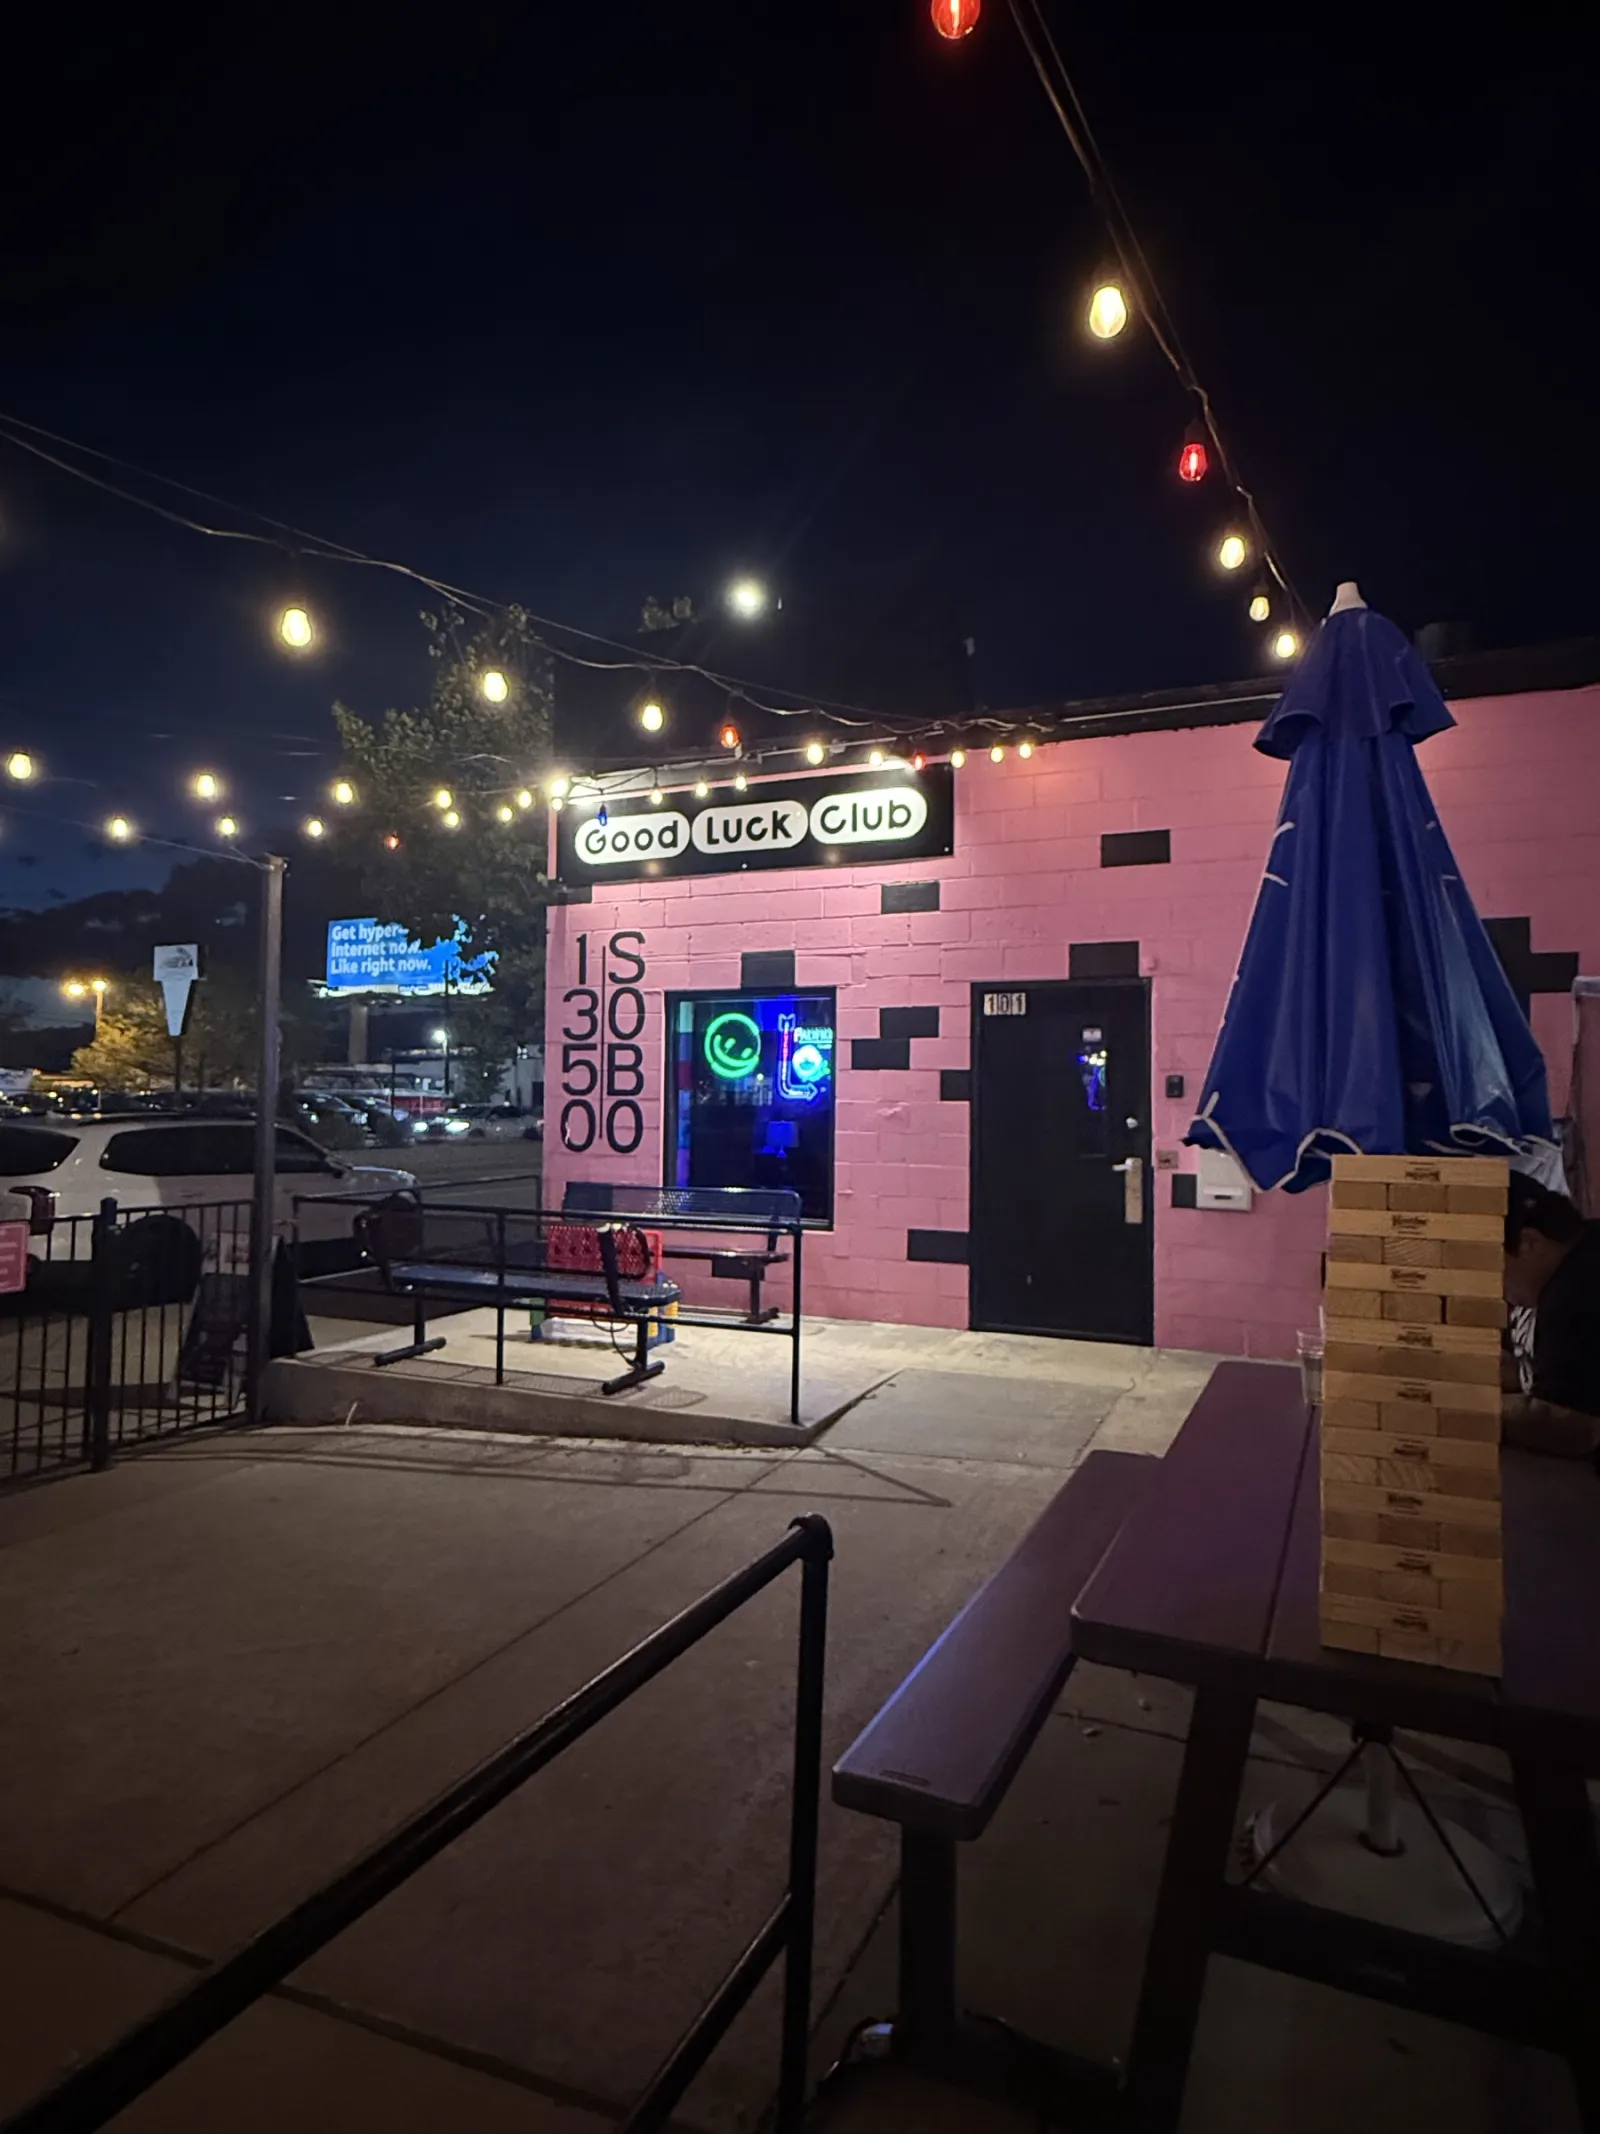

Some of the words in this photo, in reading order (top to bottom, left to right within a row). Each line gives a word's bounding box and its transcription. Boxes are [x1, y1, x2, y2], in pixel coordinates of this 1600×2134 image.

[584, 819, 679, 855] Good
[706, 810, 793, 845] Luck
[819, 799, 912, 835] Club
[331, 925, 357, 941] Get
[331, 958, 359, 974] Like
[360, 956, 395, 977] right
[397, 958, 431, 973] now.
[987, 994, 1023, 1014] 101
